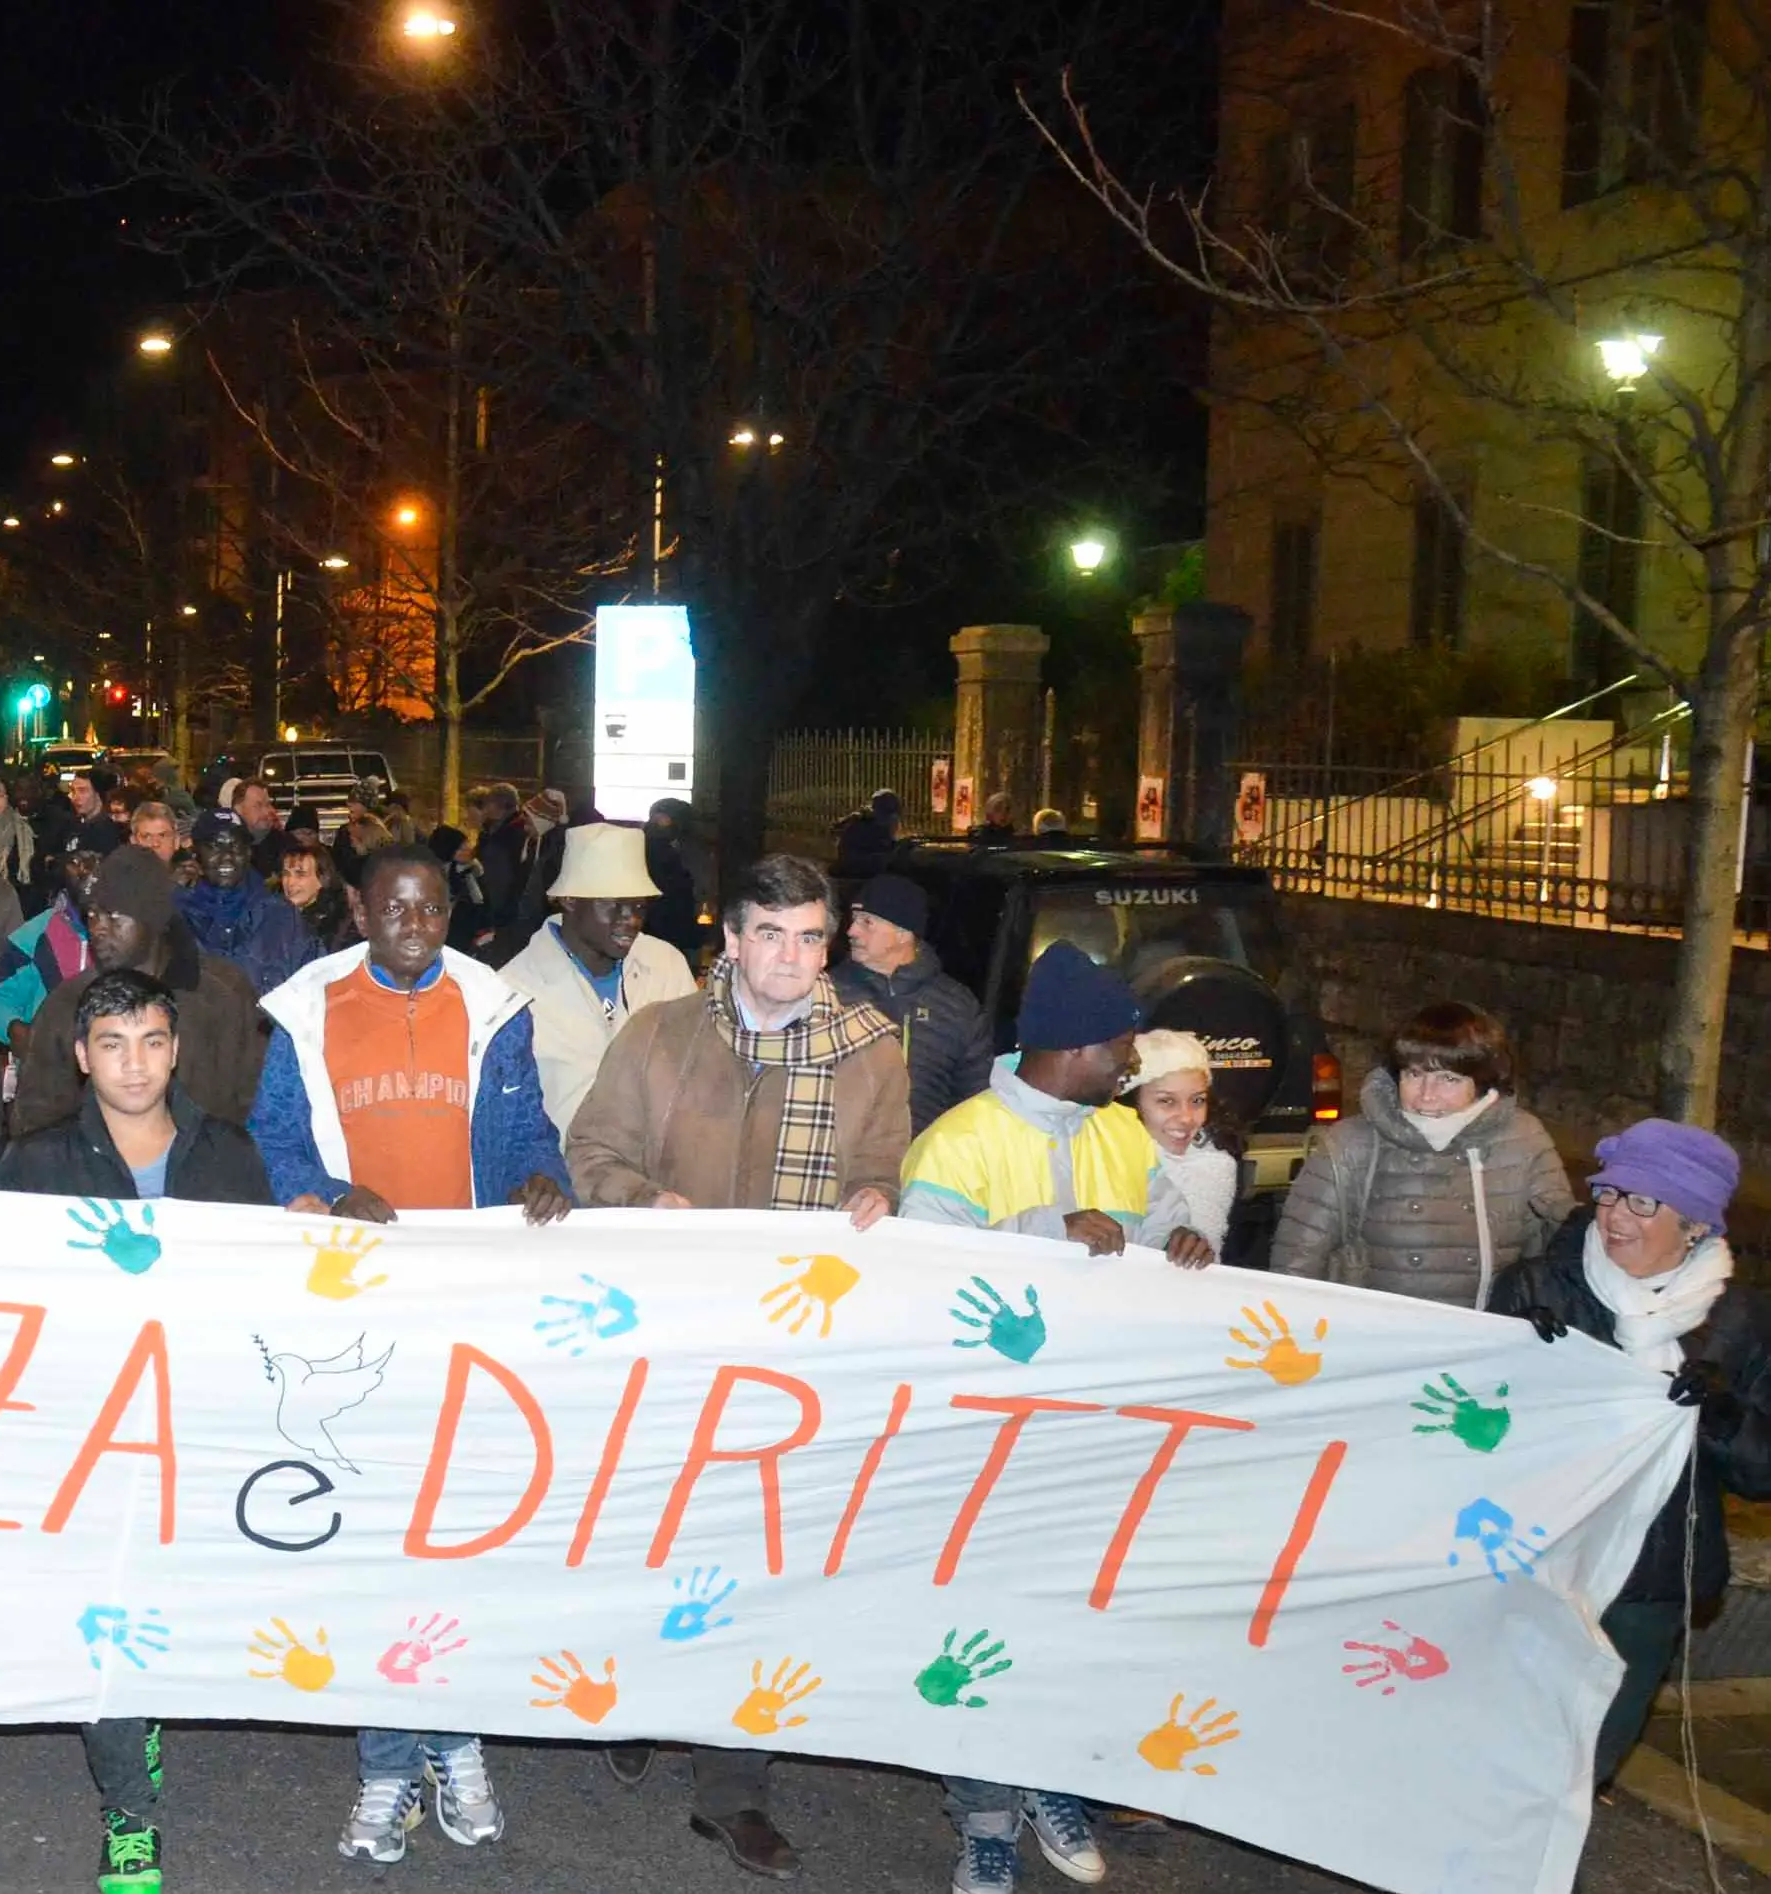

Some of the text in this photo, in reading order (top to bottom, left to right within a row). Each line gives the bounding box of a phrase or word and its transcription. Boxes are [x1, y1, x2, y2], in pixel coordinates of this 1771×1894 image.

[615, 617, 673, 693] P
[1094, 889, 1198, 904] SUZUKI
[340, 1071, 468, 1114] CHAMPIO
[236, 1460, 342, 1552] e
[403, 1342, 1347, 1648] DIRITTI
